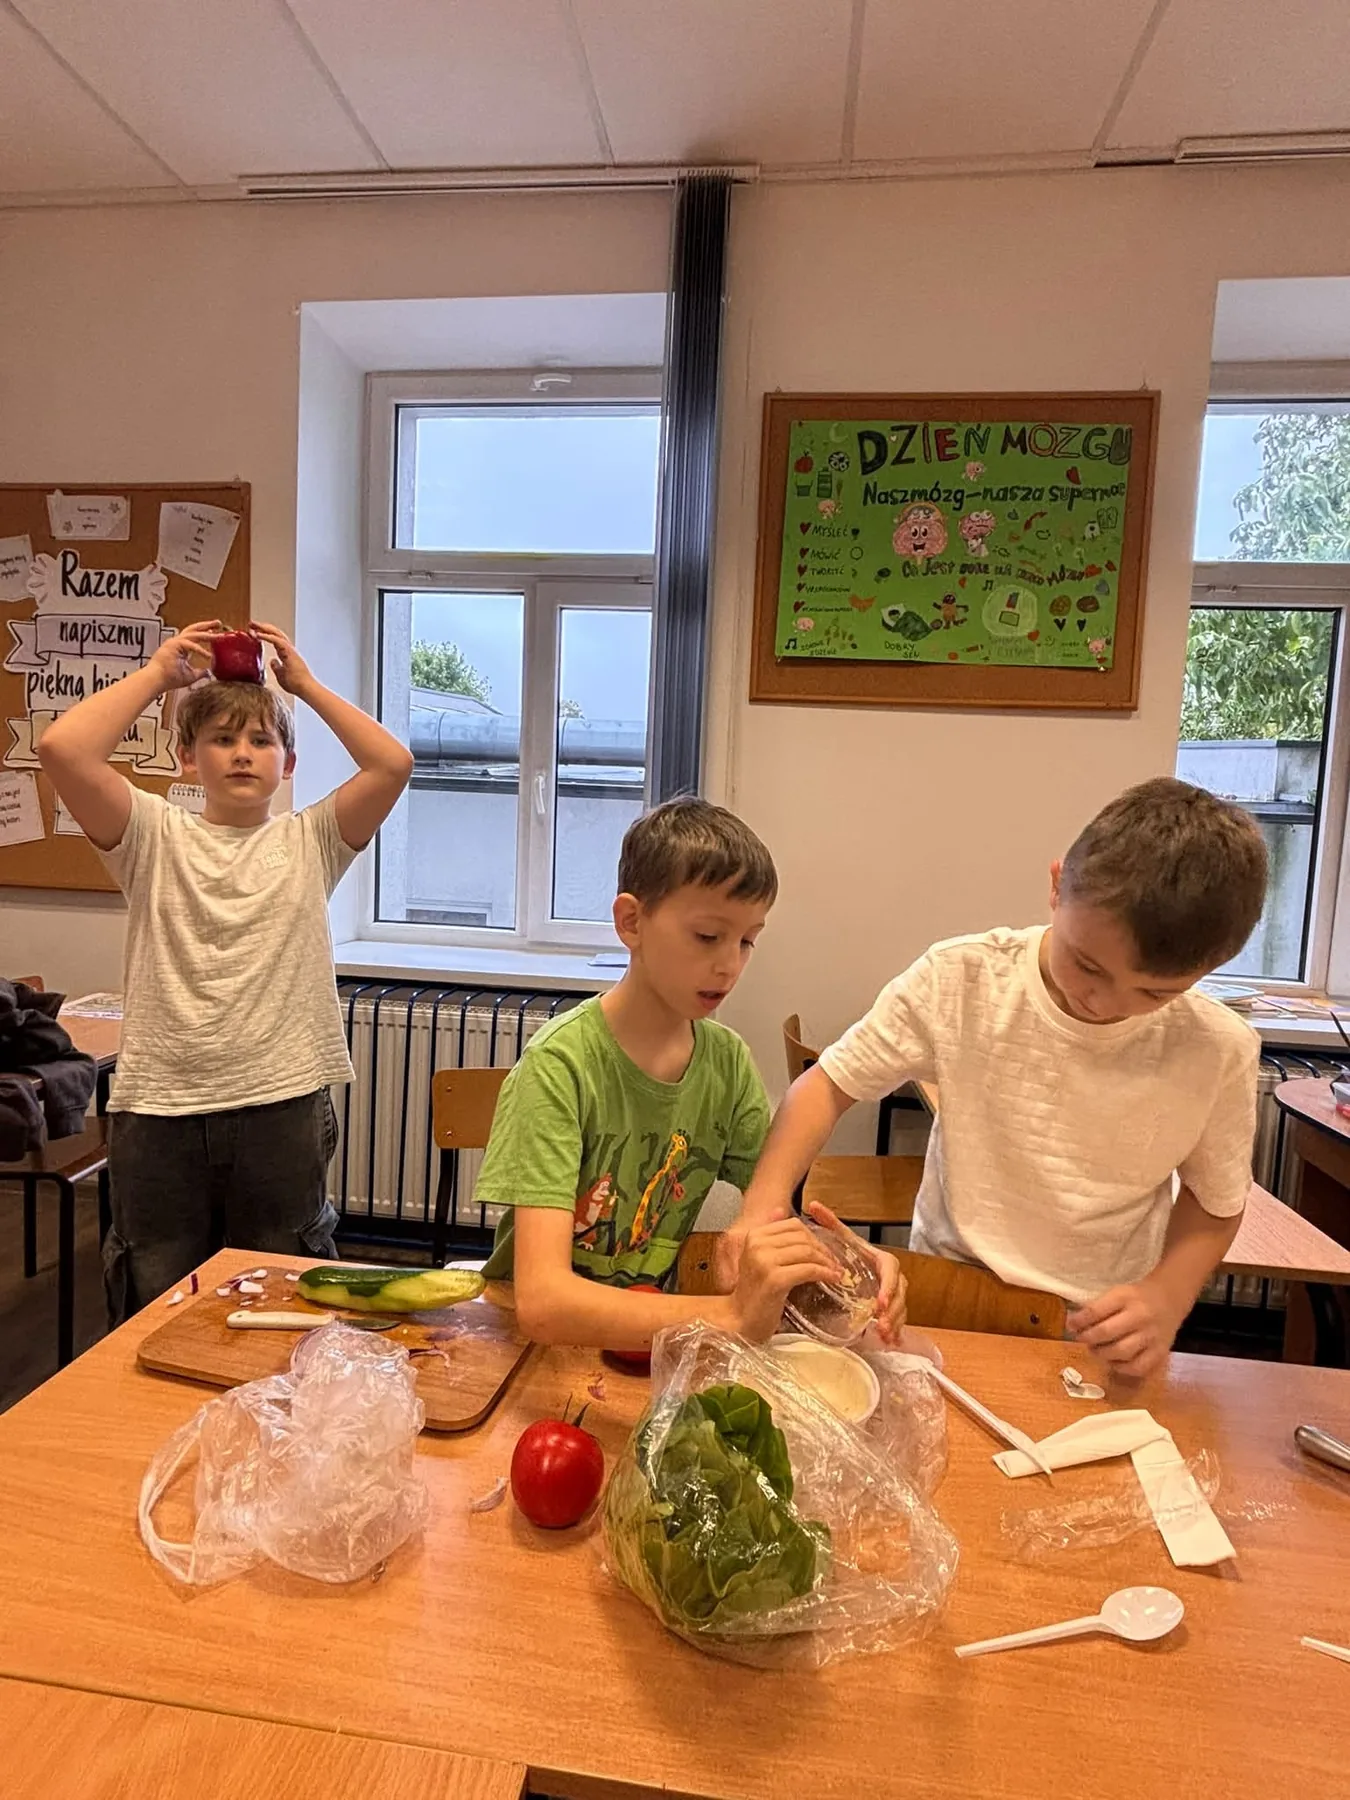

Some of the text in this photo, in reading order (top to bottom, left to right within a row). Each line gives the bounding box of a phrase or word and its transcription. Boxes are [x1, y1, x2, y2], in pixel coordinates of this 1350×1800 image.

[857, 422, 992, 476] DZIEŃ
[61, 550, 140, 600] Razem
[60, 619, 145, 660] napiszmy
[28, 660, 85, 708] piękną
